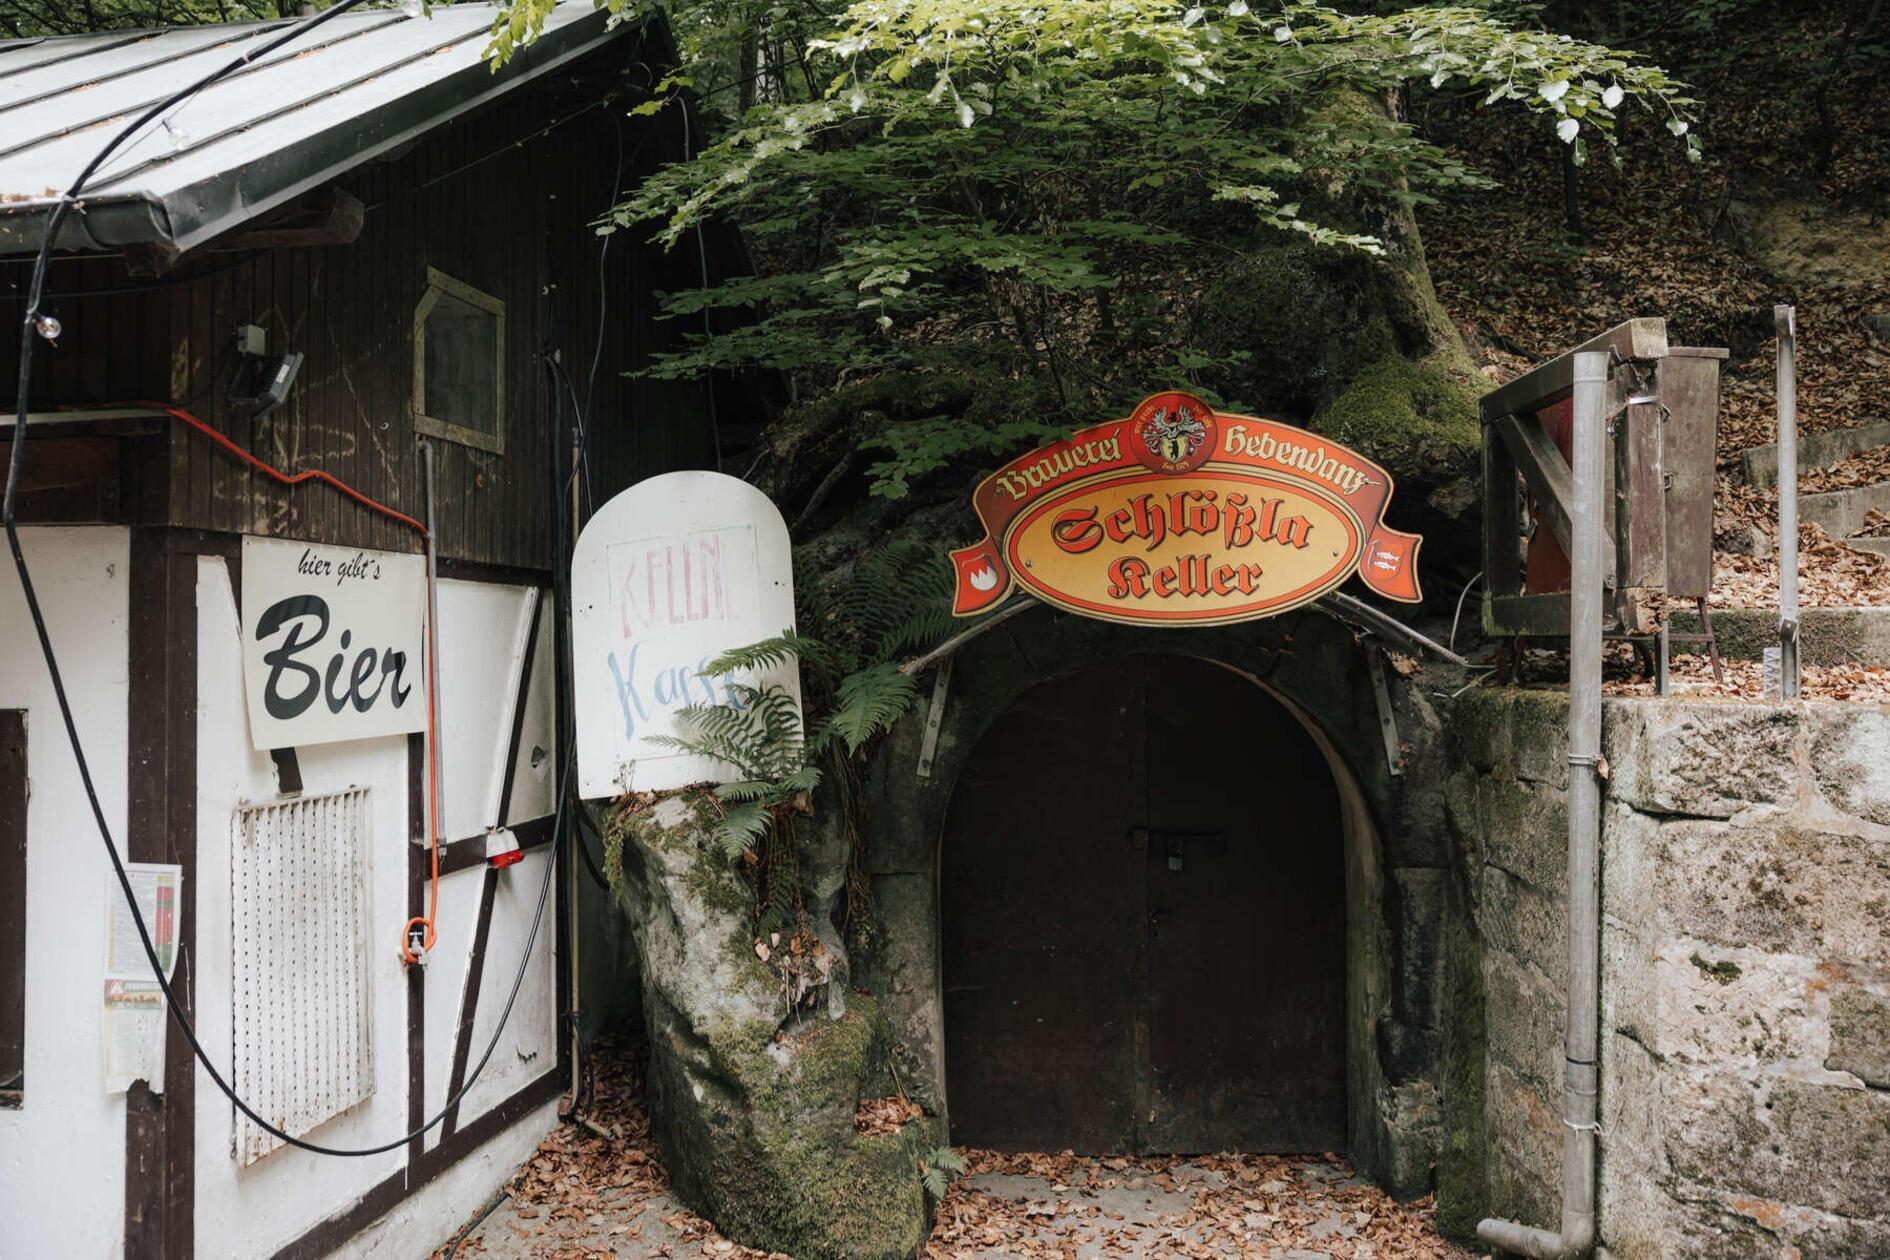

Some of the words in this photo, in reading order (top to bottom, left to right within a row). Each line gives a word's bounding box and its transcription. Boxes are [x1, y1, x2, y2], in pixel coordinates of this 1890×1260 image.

[996, 428, 1122, 500] Brauerei
[1051, 490, 1314, 553] Schlößla
[297, 548, 332, 576] hier
[1107, 554, 1263, 599] Keller
[255, 594, 412, 720] Bier
